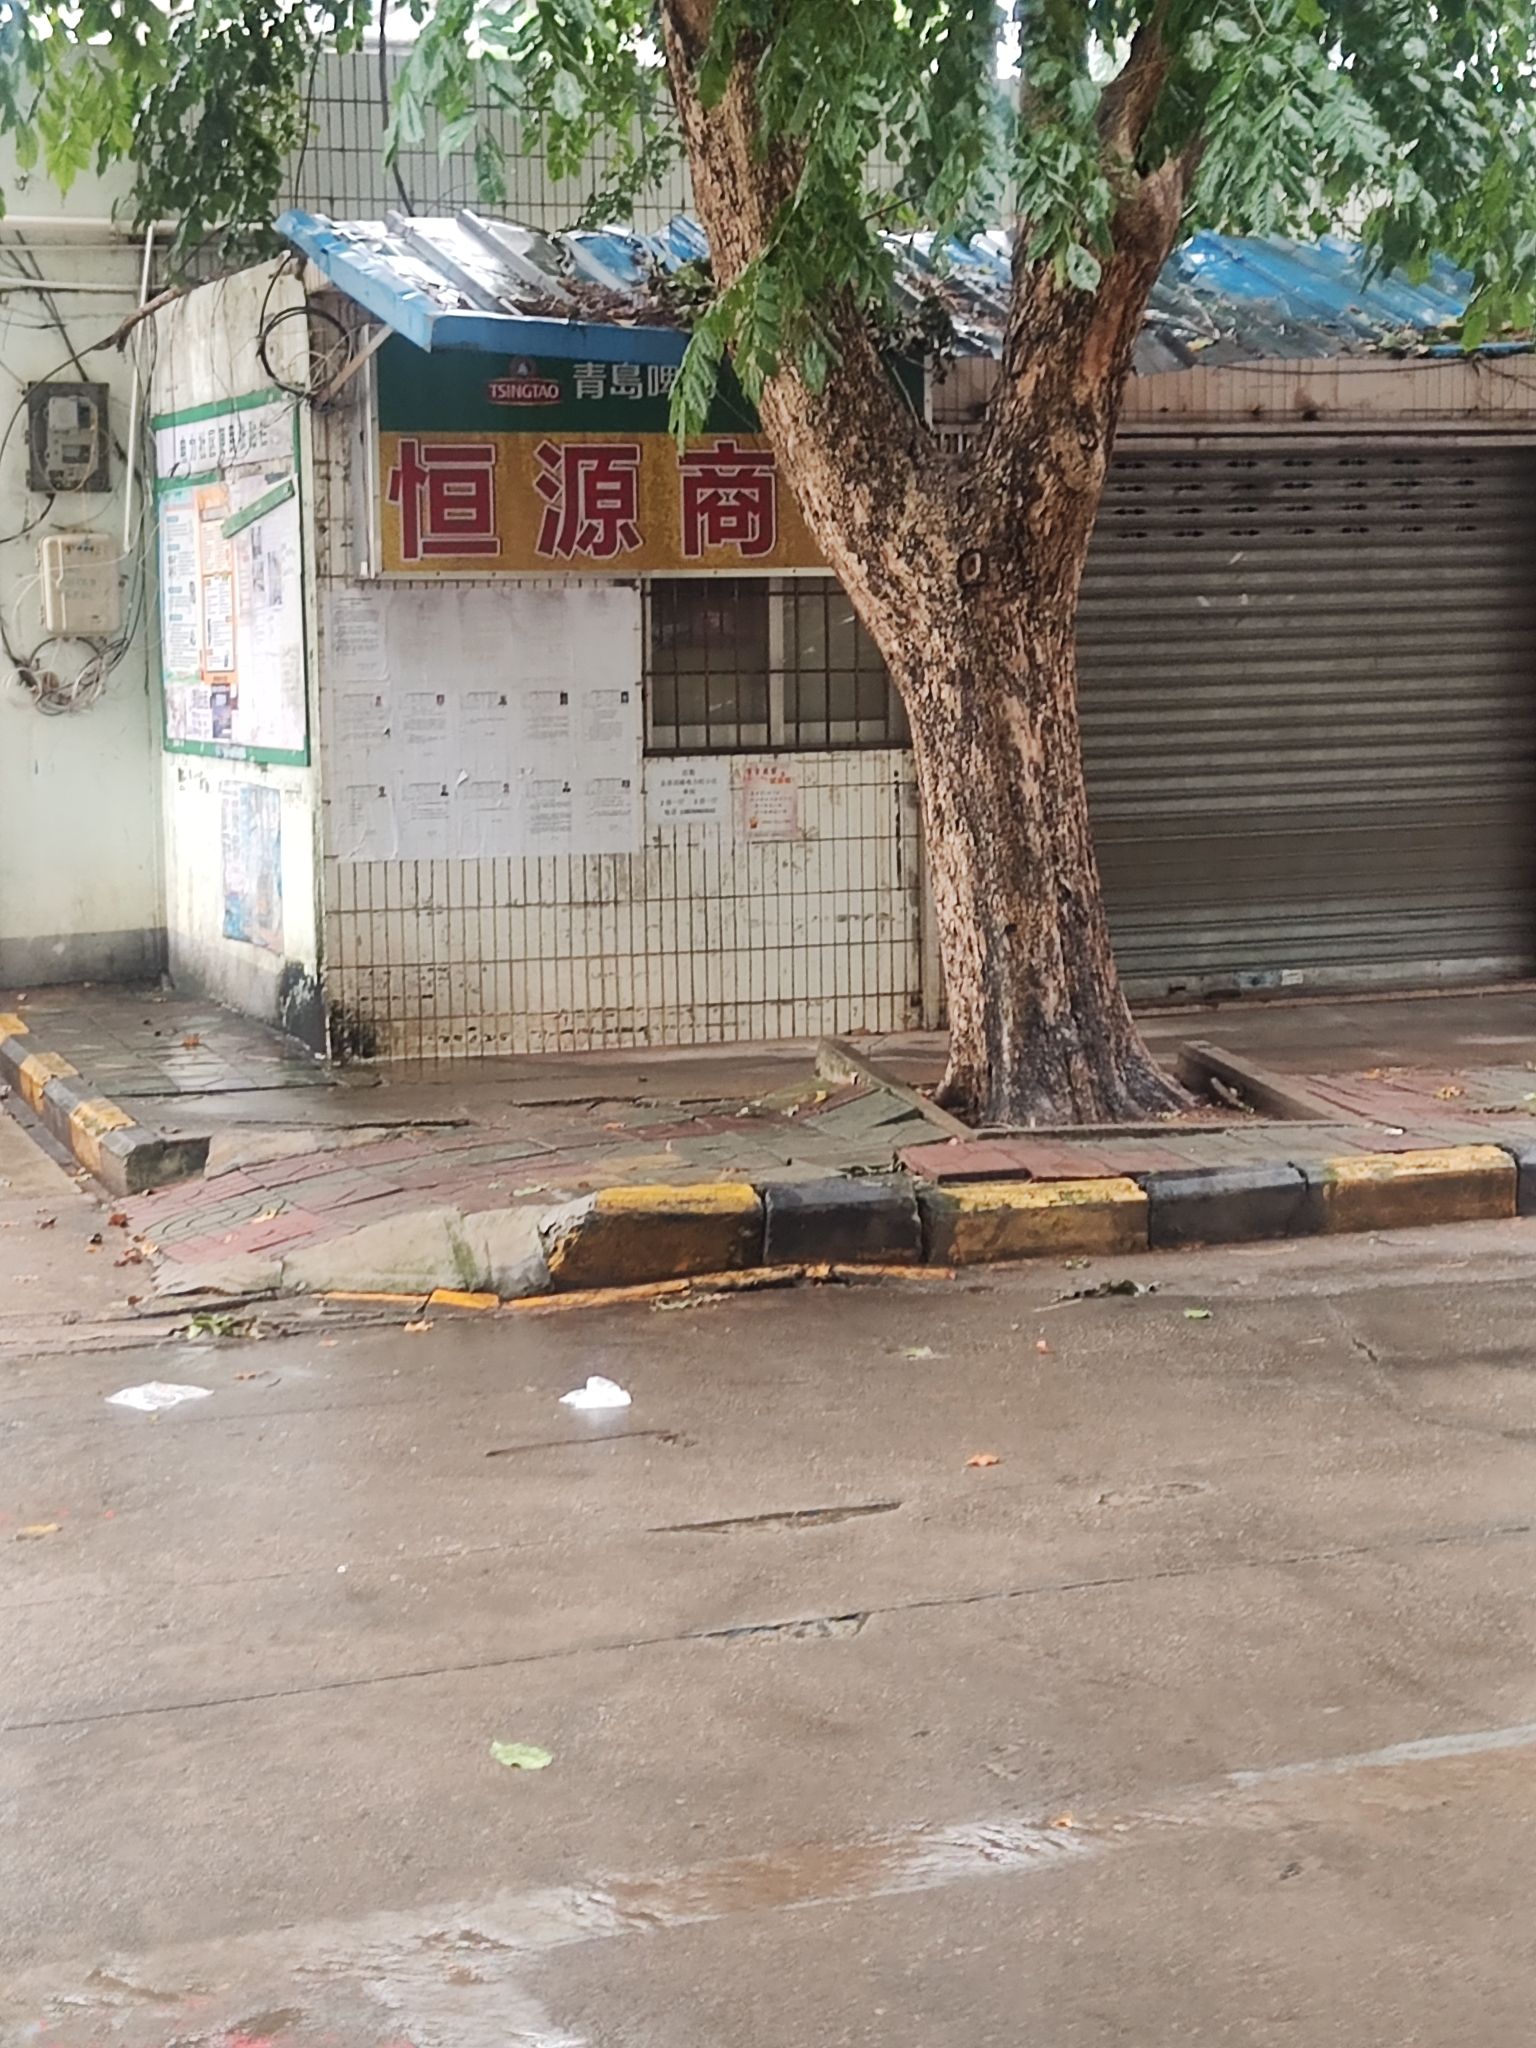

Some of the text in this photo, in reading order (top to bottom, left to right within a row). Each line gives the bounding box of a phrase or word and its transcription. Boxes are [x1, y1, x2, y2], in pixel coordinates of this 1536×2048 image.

[488, 383, 560, 399] TSINGTAO
[387, 438, 776, 560] 恒源商
